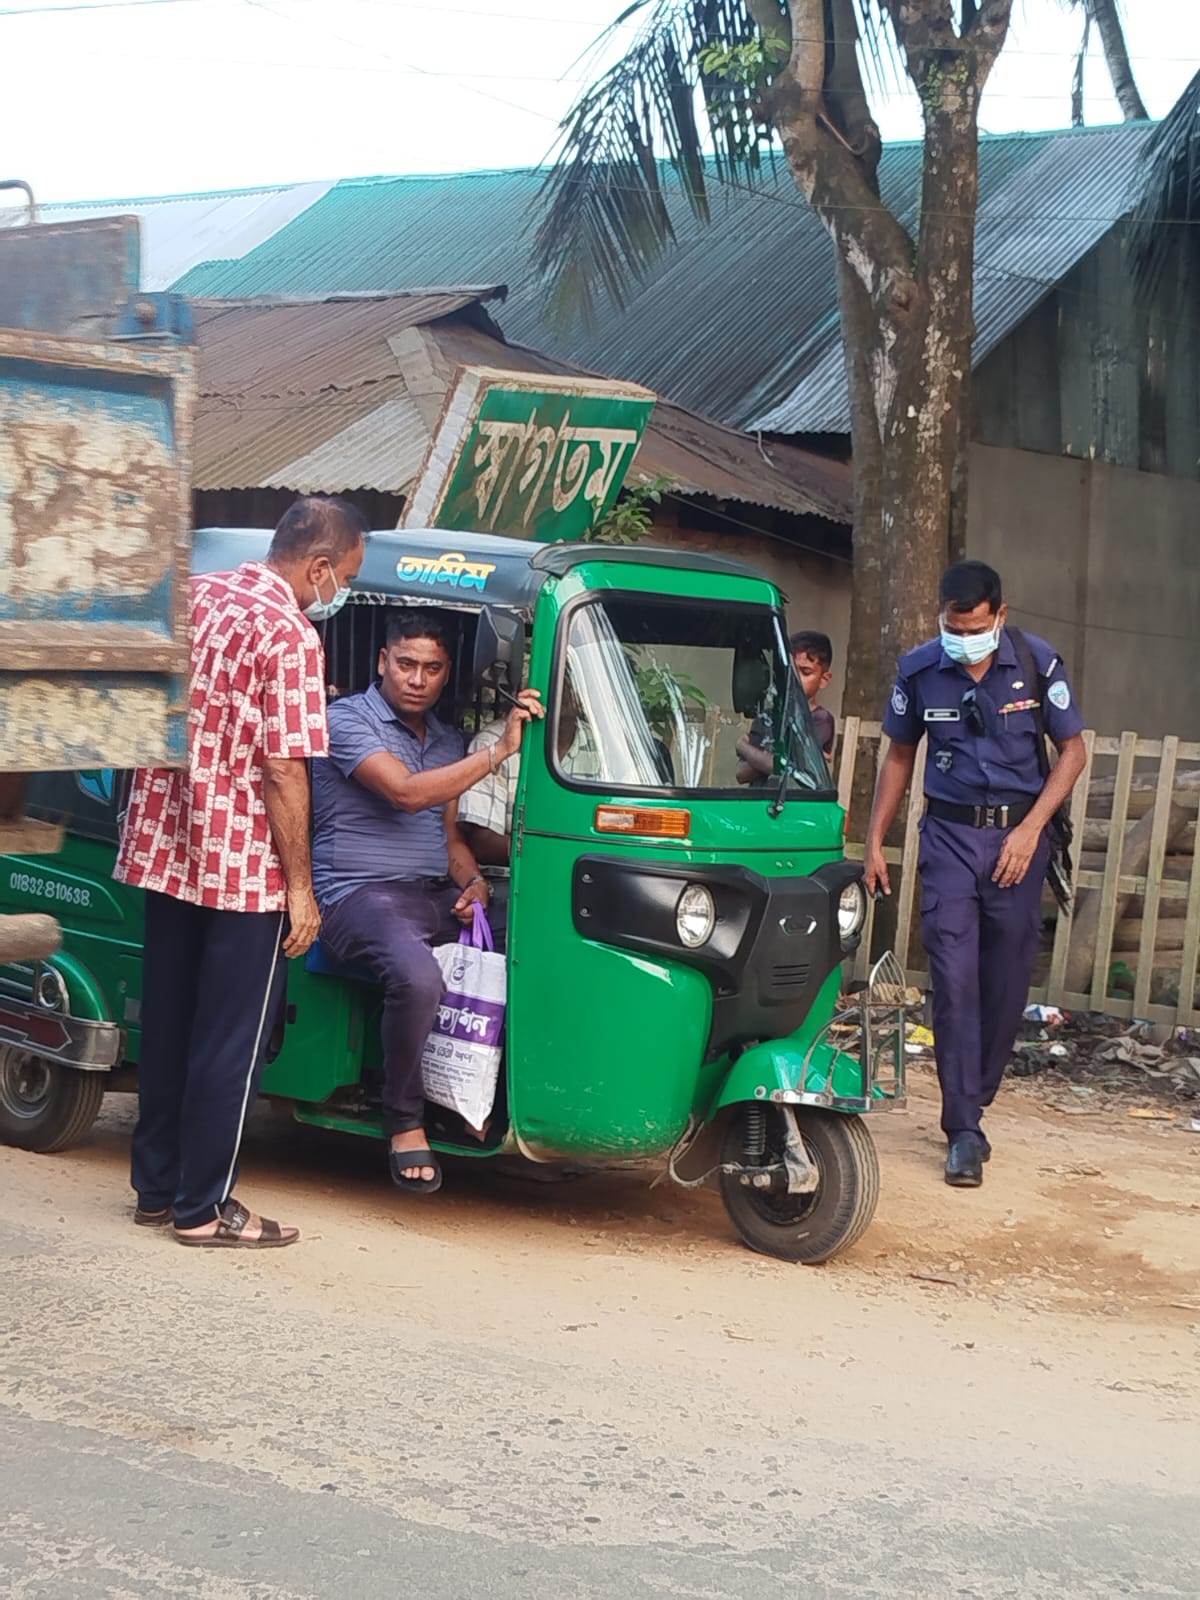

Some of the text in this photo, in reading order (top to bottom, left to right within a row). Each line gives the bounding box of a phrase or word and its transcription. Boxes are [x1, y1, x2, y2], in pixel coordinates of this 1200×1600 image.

[475, 407, 637, 529] স্বাগতম
[397, 552, 496, 592] তামিম
[437, 1004, 491, 1037] ফ্যাশন
